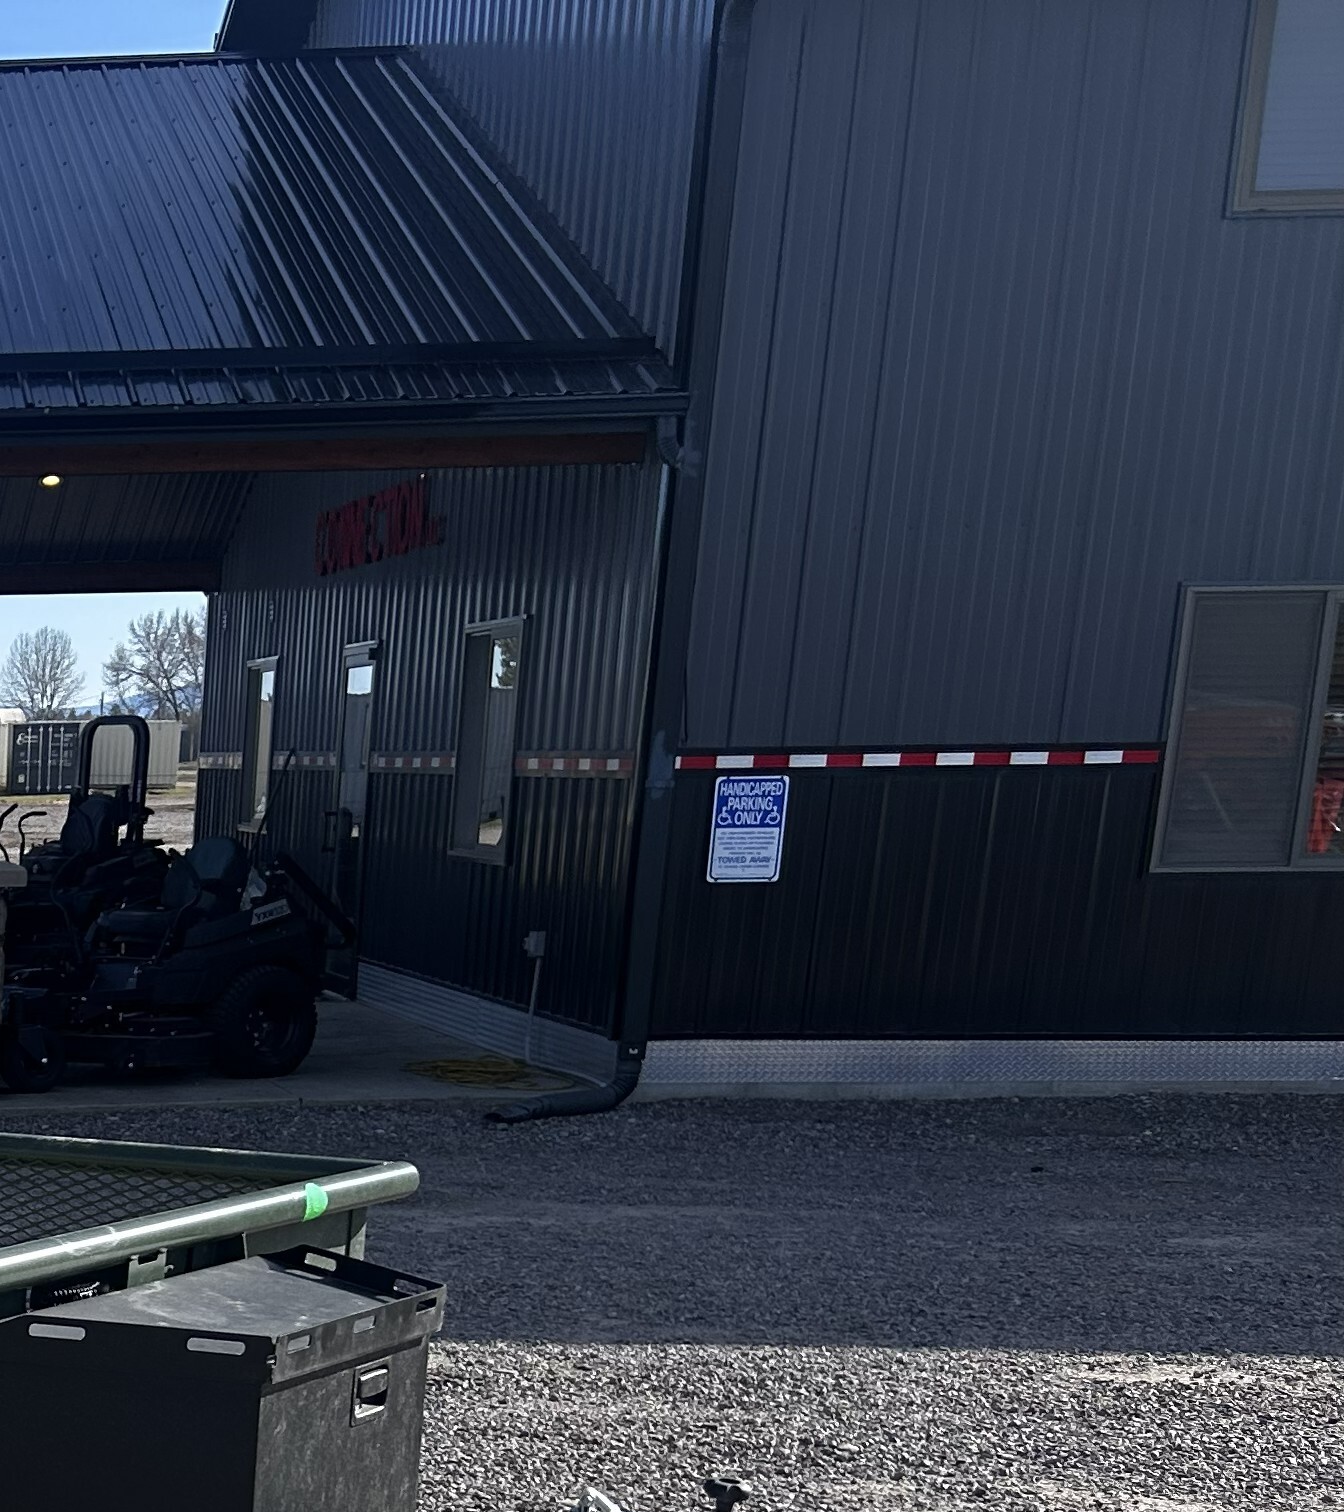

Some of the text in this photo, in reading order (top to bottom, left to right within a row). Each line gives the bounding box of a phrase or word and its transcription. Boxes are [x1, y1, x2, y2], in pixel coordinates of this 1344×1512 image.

[720, 782, 783, 796] HANDICAPPED
[727, 797, 773, 810] PARKING
[734, 811, 763, 825] ONLY
